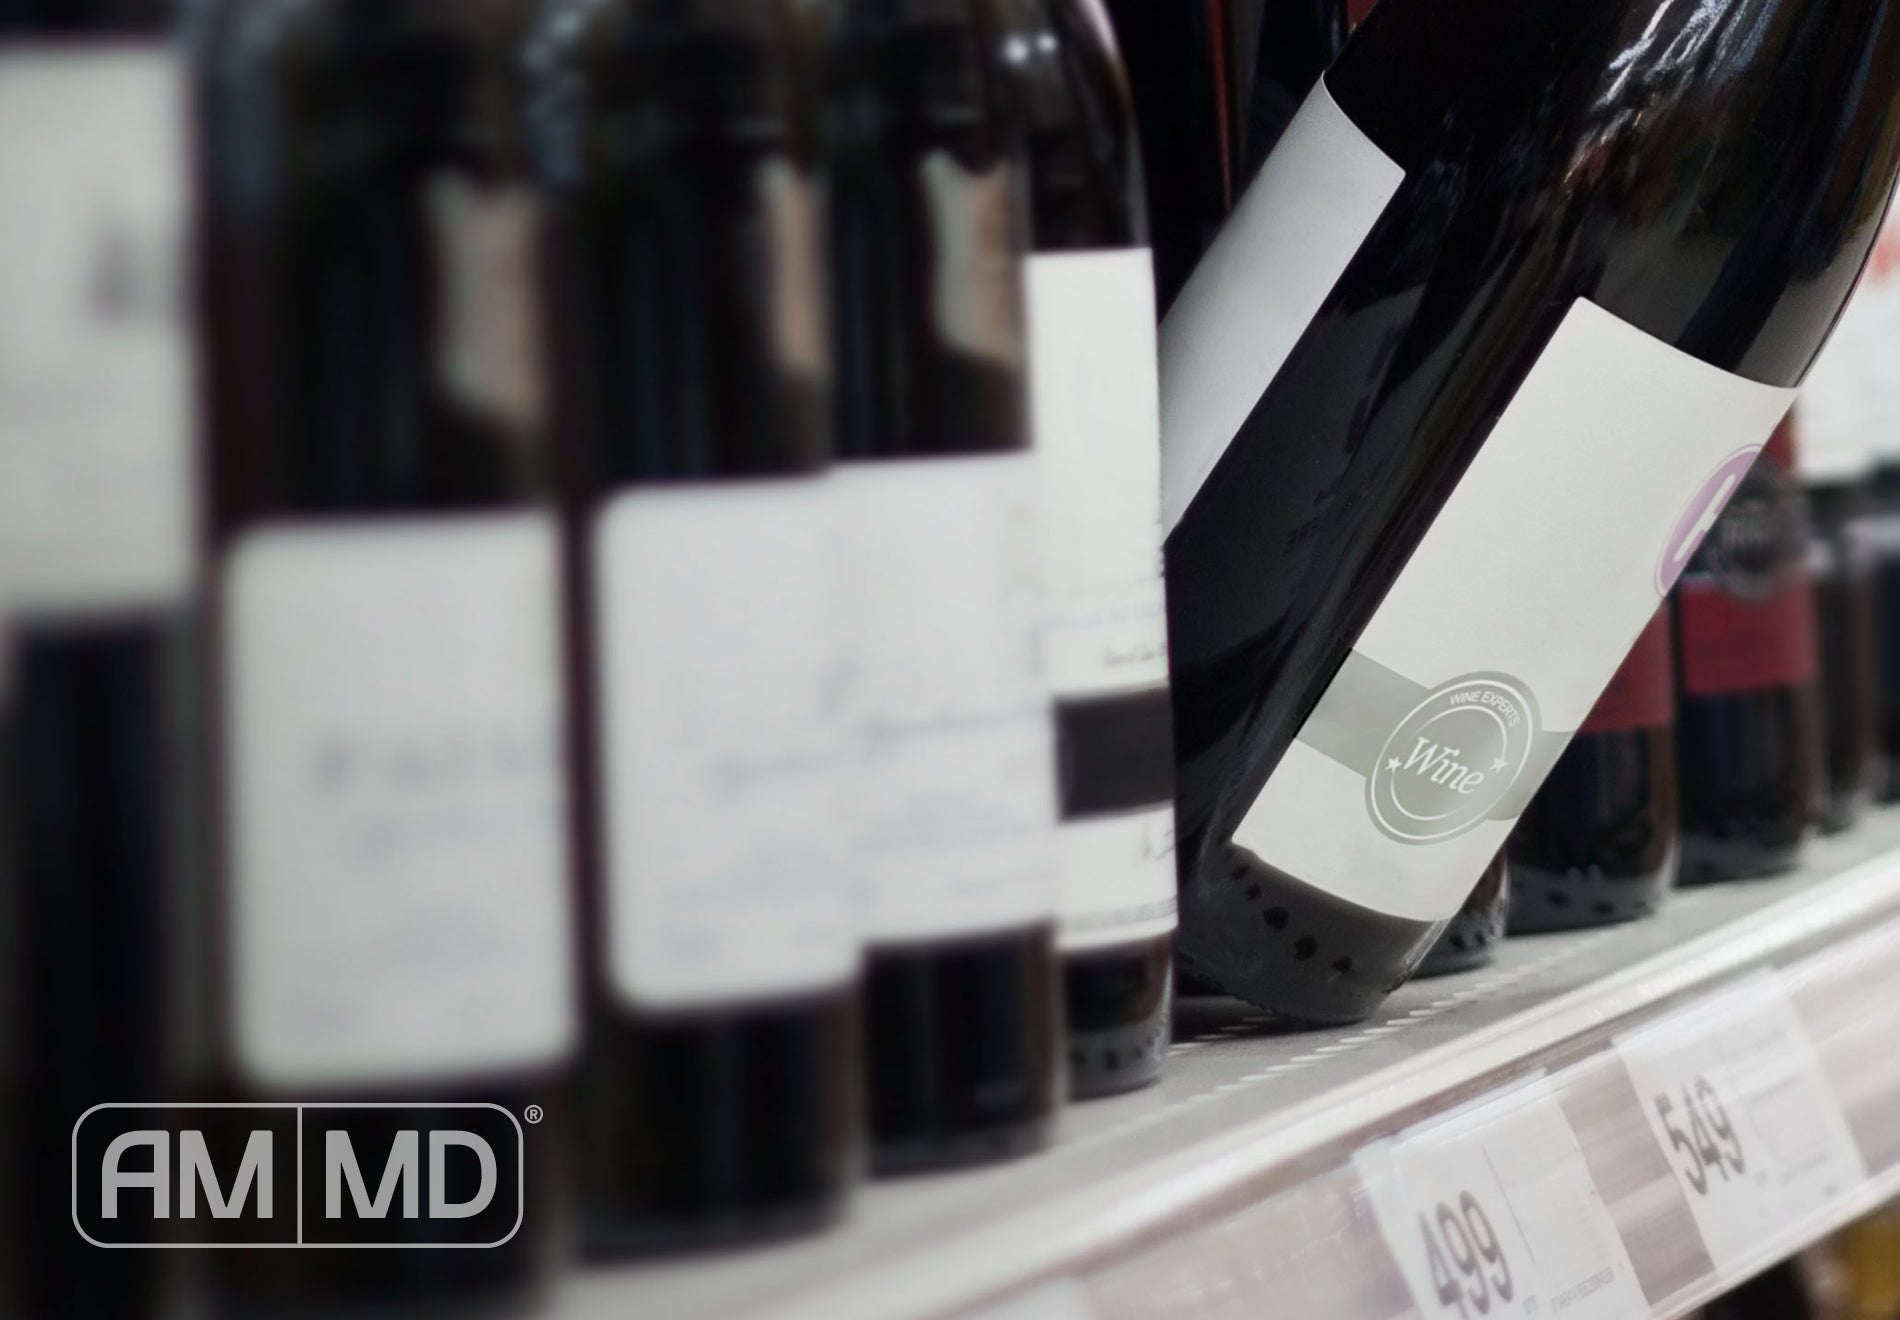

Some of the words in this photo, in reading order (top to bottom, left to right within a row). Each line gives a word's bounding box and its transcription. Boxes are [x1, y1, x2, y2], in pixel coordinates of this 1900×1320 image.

[1450, 690, 1481, 705] WINE
[1481, 691, 1520, 727] EXPERTS
[1403, 736, 1485, 794] Wine
[1655, 1075, 1745, 1196] 549
[1417, 1190, 1513, 1320] 499
